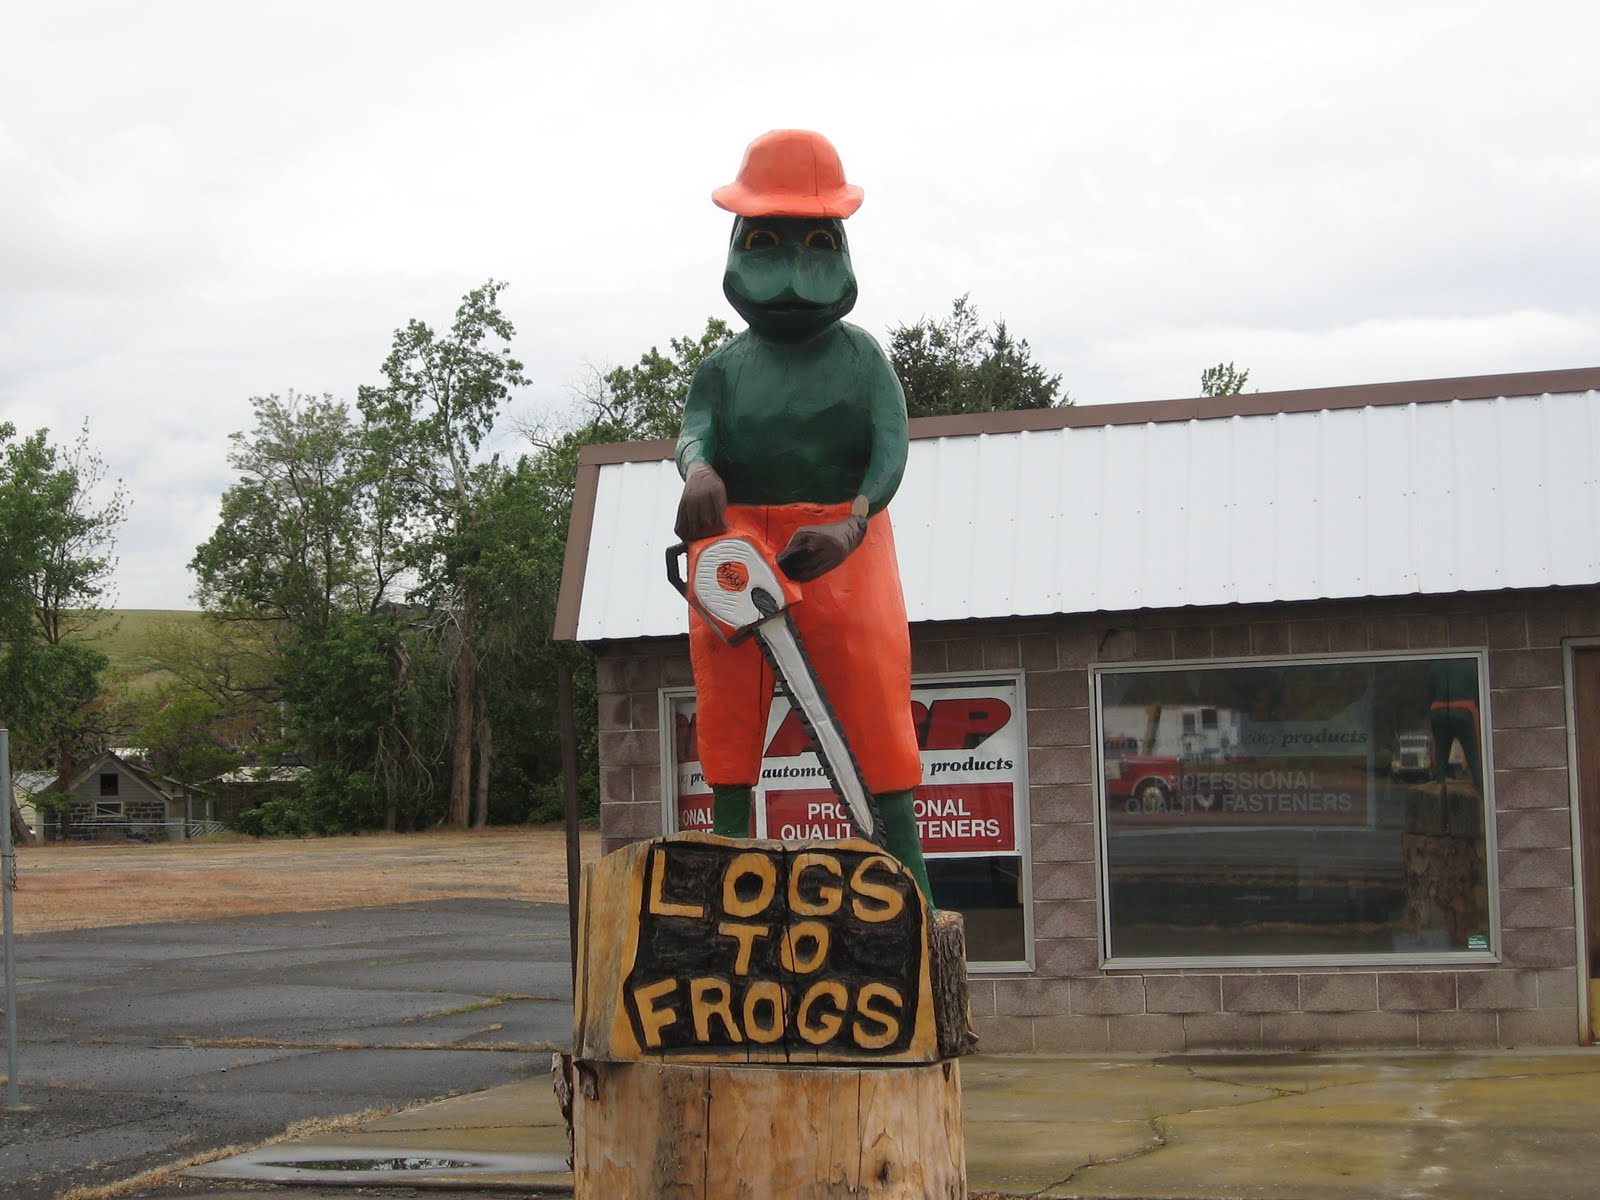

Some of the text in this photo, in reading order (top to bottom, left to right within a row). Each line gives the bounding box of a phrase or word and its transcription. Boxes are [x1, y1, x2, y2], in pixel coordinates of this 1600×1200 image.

[1281, 728, 1368, 747] products
[762, 765, 828, 778] automo
[931, 757, 1013, 776] products
[1222, 793, 1352, 812] FASTENERS
[780, 819, 1000, 840] QUALIT TENERS
[649, 849, 904, 922] LOGS
[718, 921, 829, 975] TO
[633, 977, 903, 1049] FROGS
